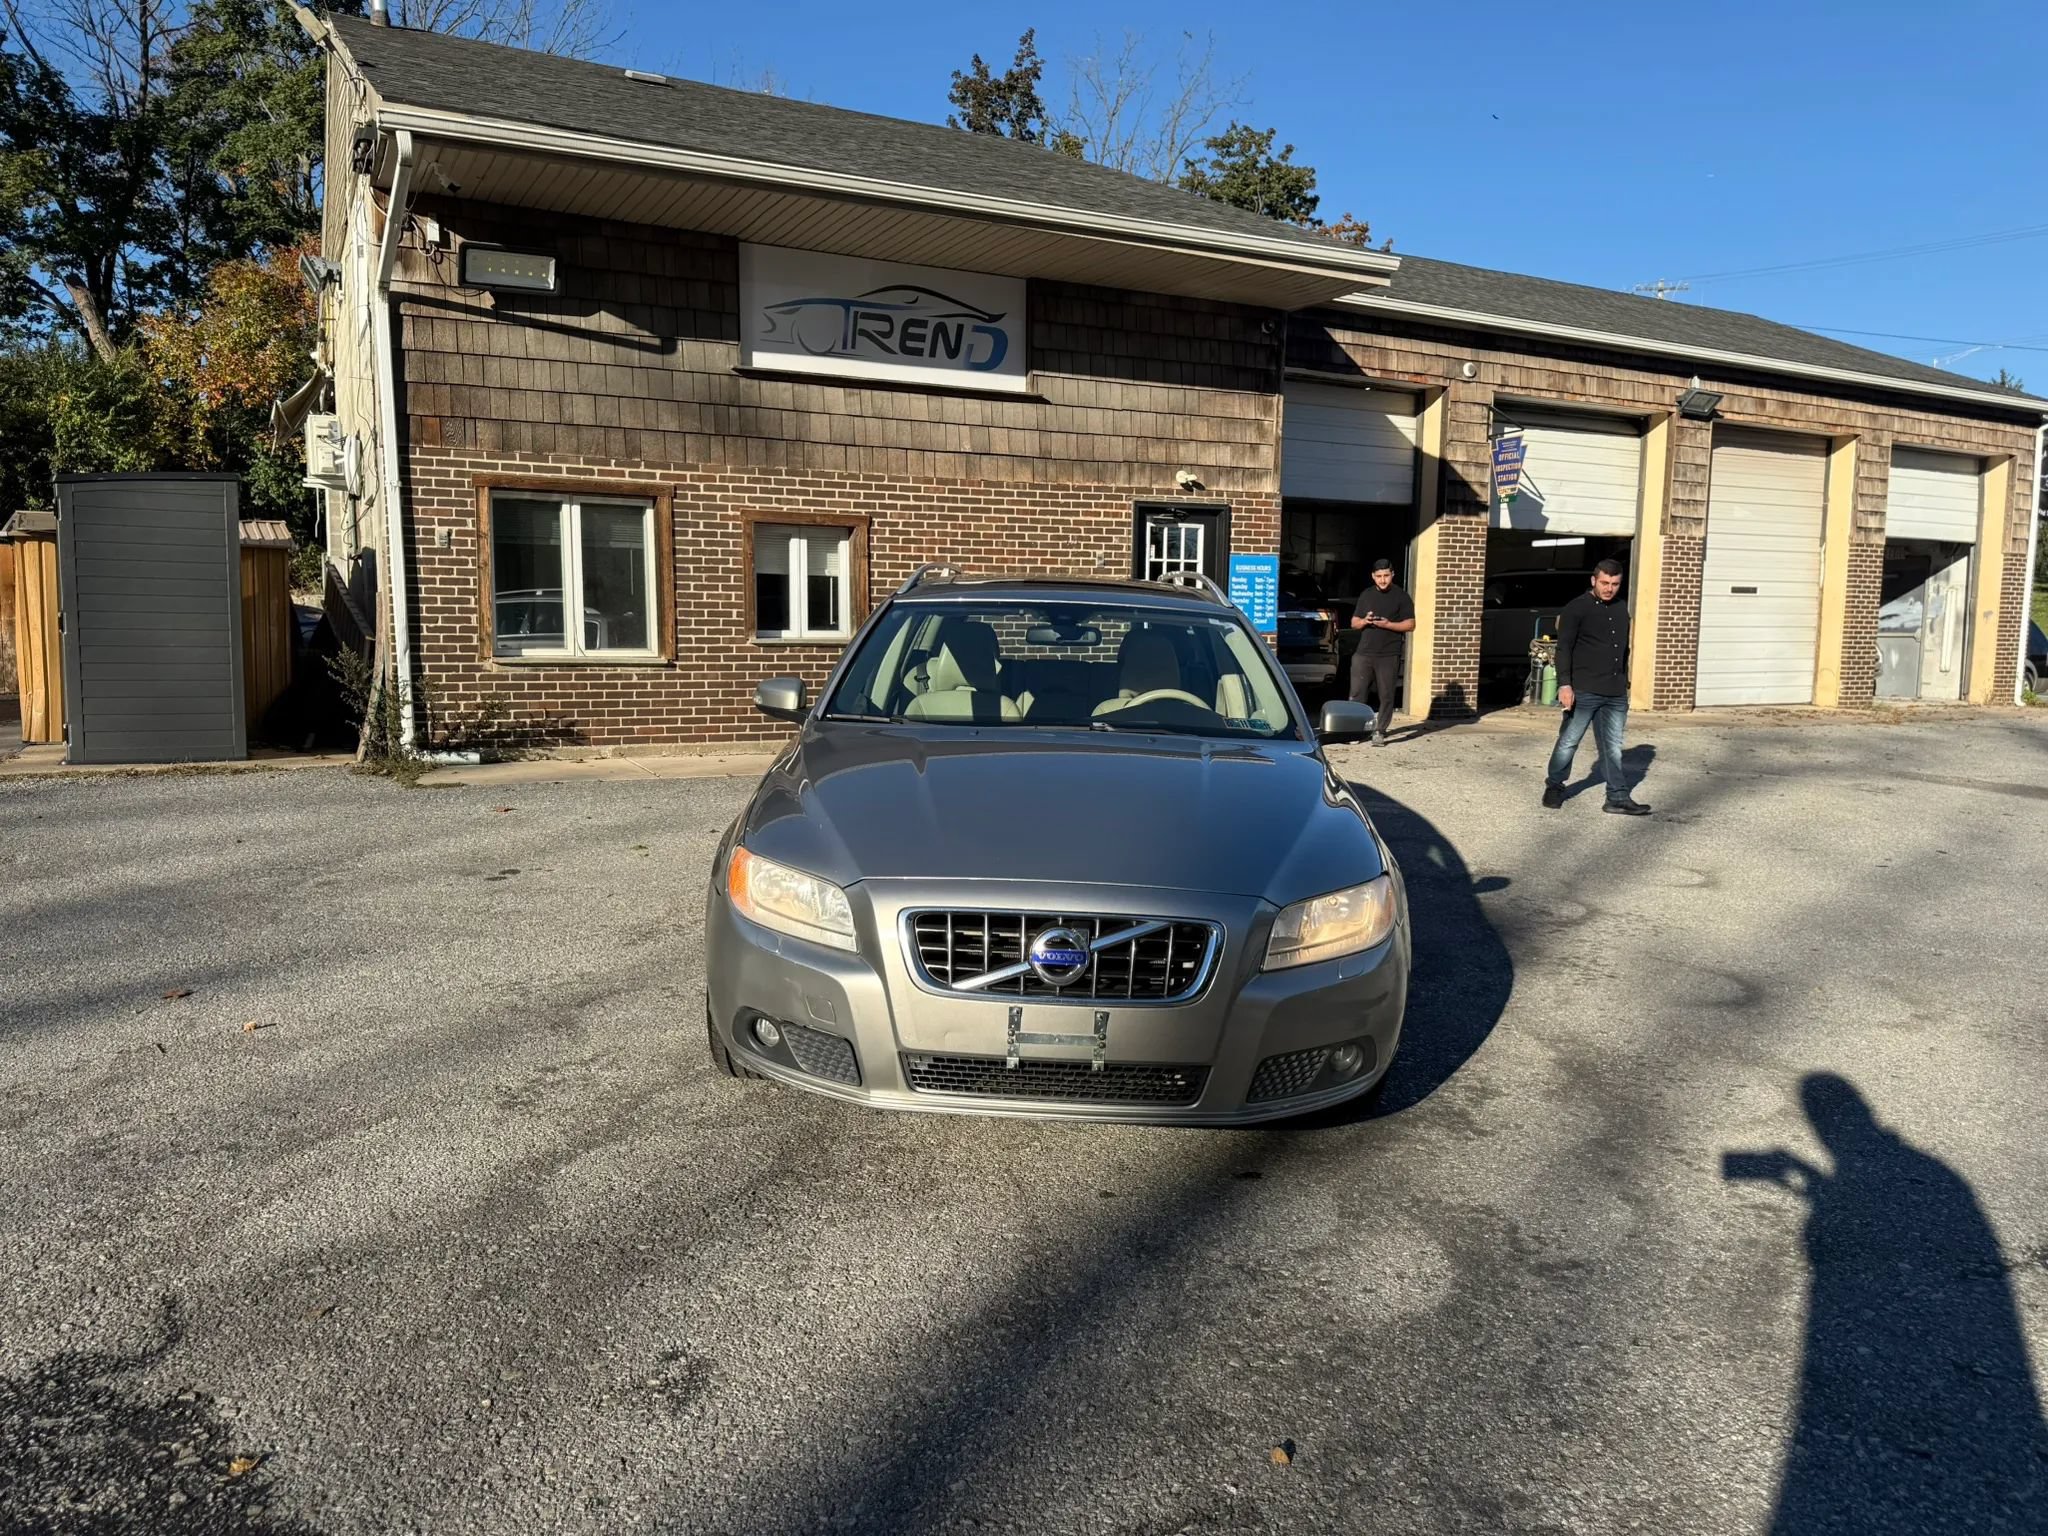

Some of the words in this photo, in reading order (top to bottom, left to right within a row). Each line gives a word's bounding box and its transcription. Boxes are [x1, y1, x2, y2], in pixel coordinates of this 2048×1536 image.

[764, 295, 1008, 372] TREND
[1498, 451, 1520, 461] OFFICIAL
[1495, 463, 1521, 472] INSPECTION
[1497, 473, 1518, 482] STATION
[1231, 583, 1248, 591] Tuesday
[1036, 951, 1084, 961] VOLVO
